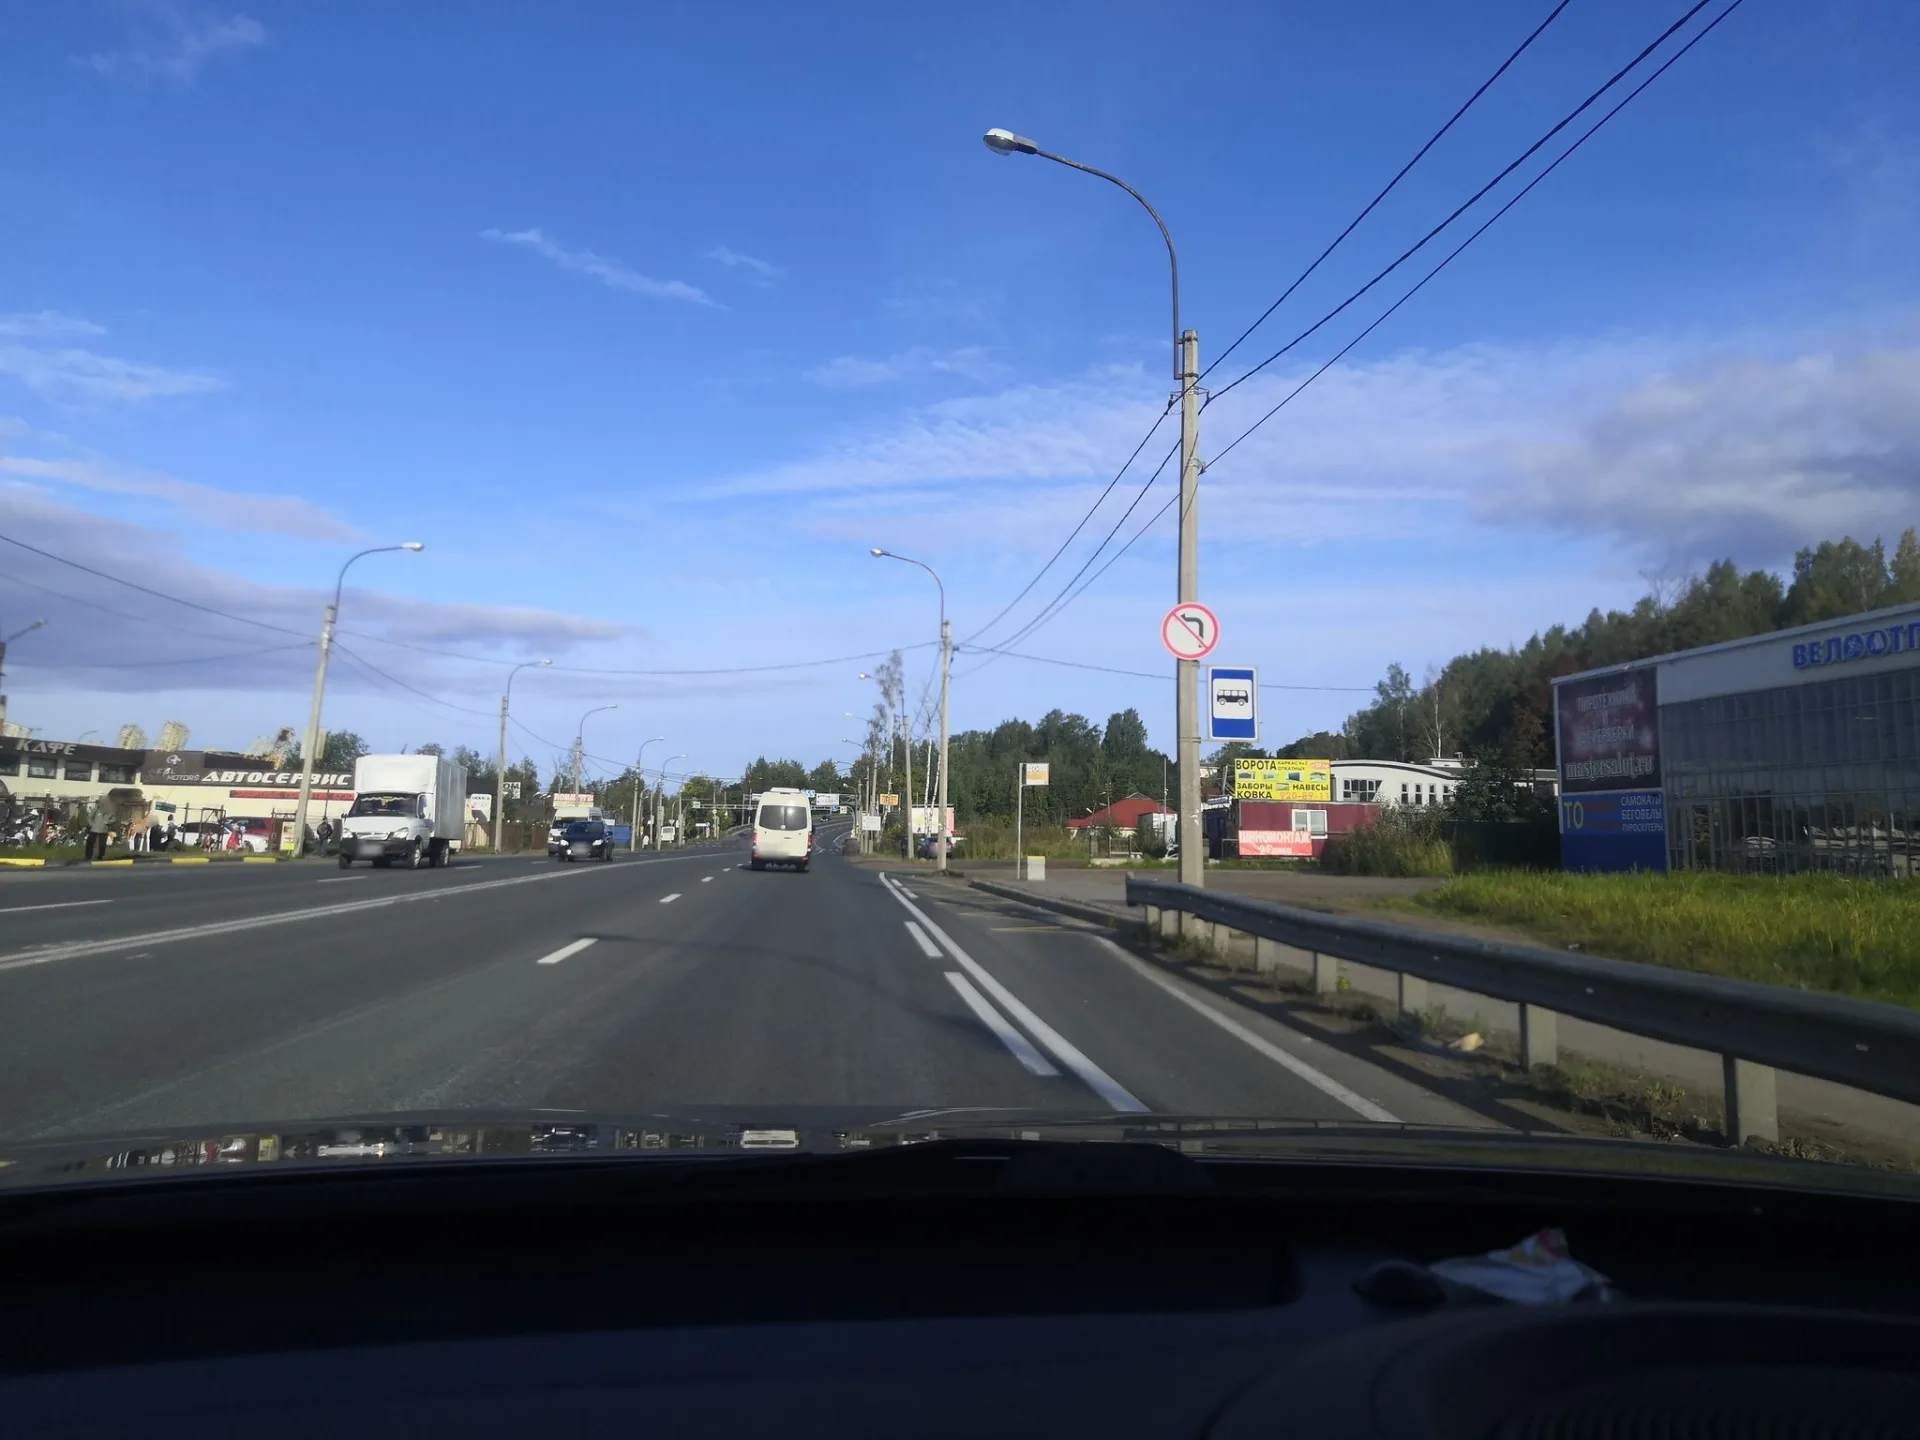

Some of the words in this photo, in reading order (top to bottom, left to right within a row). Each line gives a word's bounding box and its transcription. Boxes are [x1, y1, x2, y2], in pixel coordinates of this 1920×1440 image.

[15, 738, 77, 755] КАФЕ
[1236, 760, 1277, 770] ВОРОТА
[1566, 752, 1655, 780] mastersalut.ru
[202, 771, 352, 786] АВТОСЕРВИС
[1237, 791, 1272, 799] КОВКА
[1621, 795, 1662, 806] САМОКАТЫ
[1564, 801, 1584, 829] ТО
[1621, 808, 1662, 820] БЕГОВЕЛЫ
[1239, 830, 1311, 843] ШИНОМОНТАЖ
